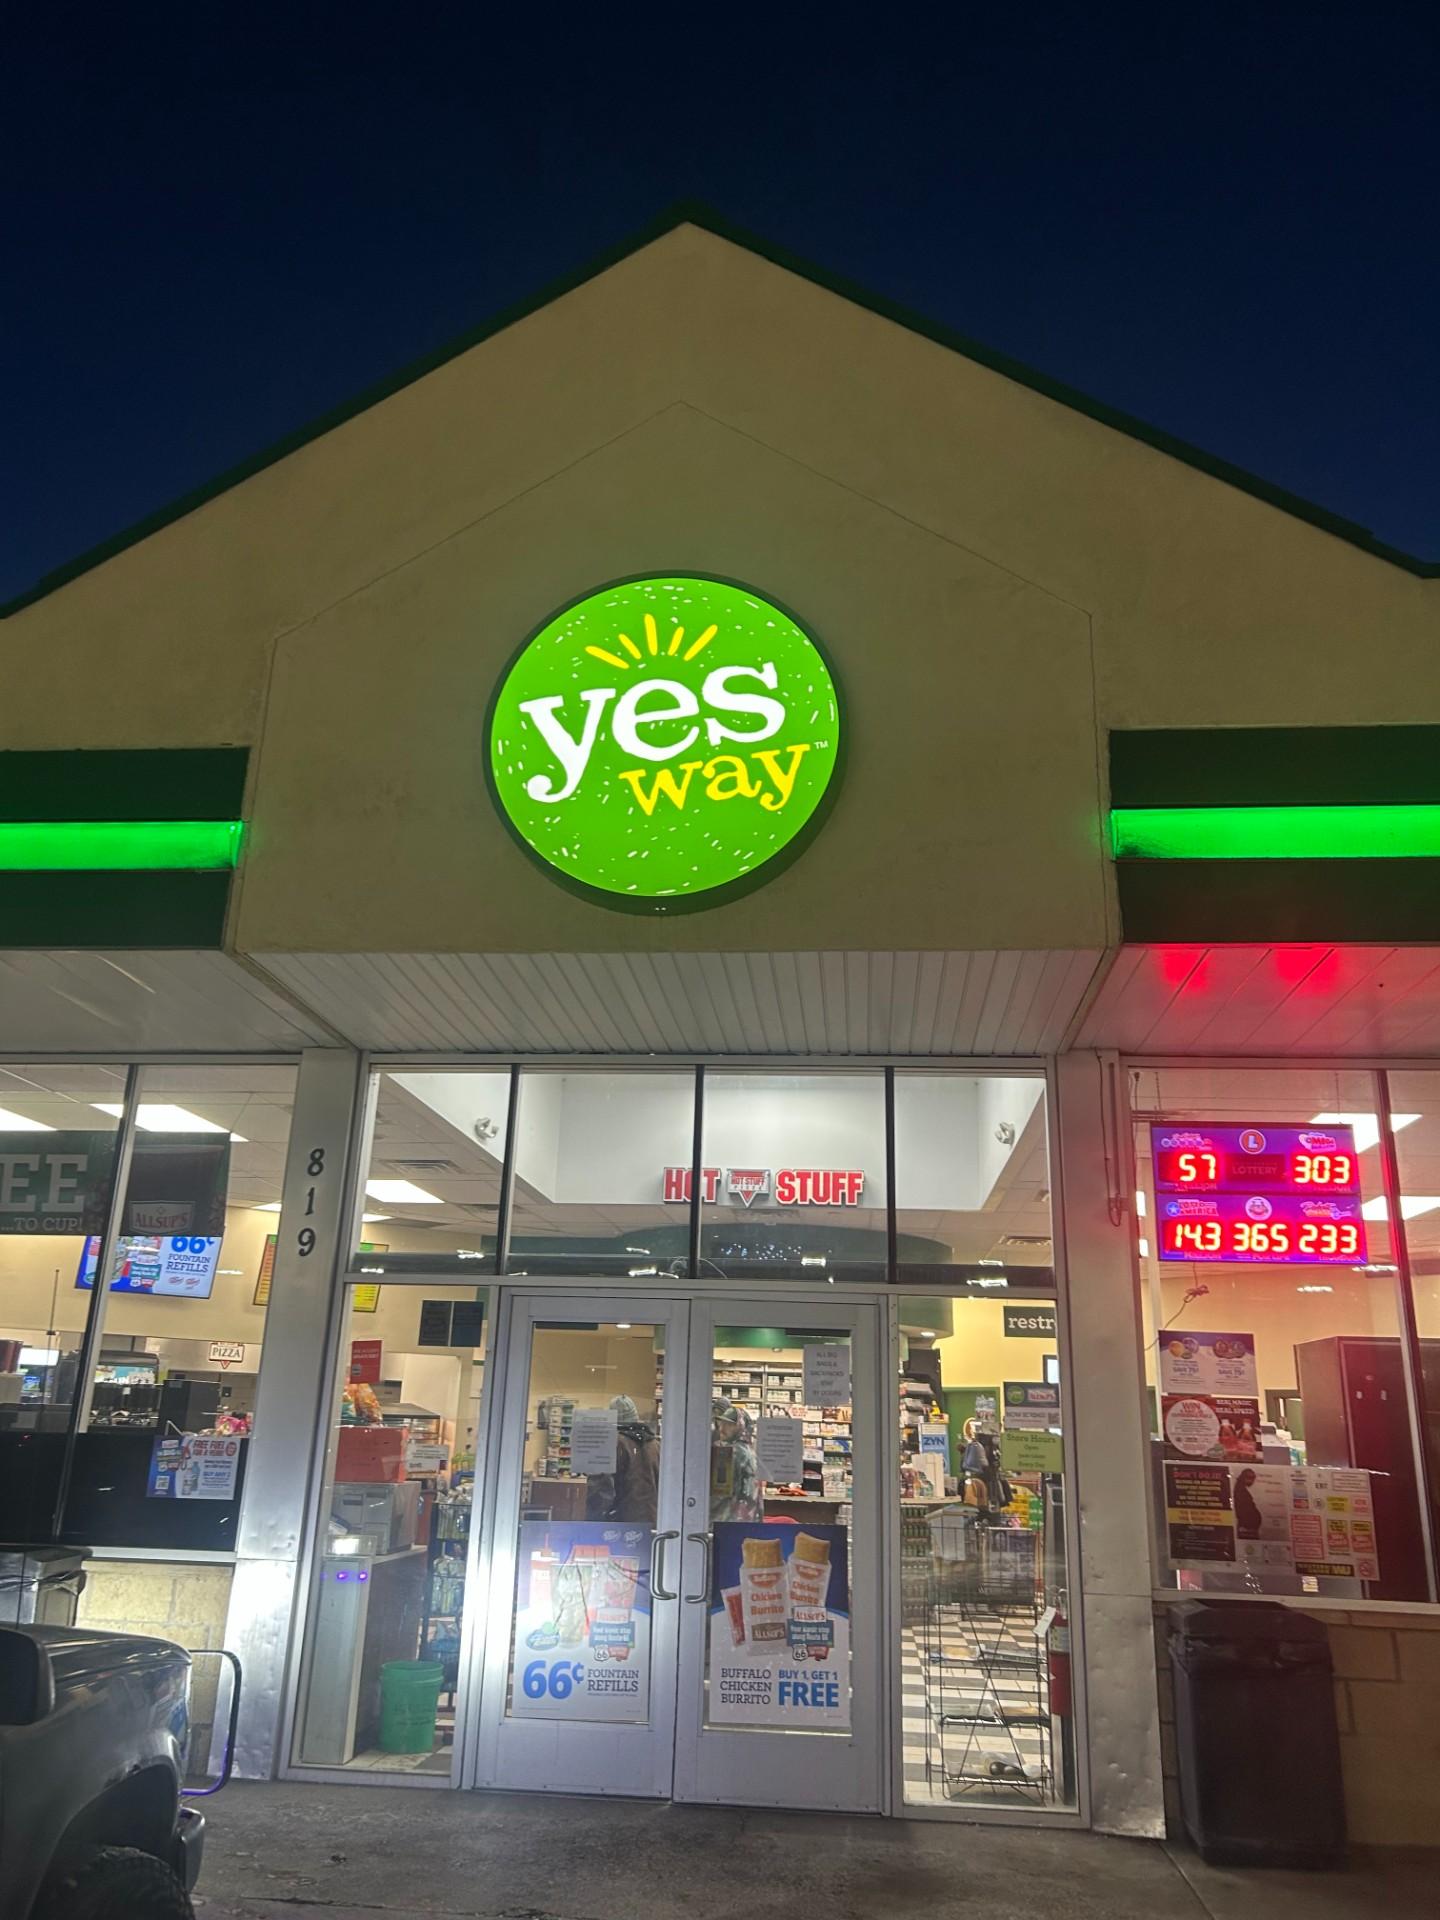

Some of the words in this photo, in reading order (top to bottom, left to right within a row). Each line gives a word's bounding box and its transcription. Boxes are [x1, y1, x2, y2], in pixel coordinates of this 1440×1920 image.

[519, 662, 786, 803] yes
[619, 744, 811, 816] way
[1178, 1153, 1216, 1182] 57
[1232, 1166, 1278, 1175] LOTTERY
[1294, 1155, 1350, 1184] 303
[776, 1169, 864, 1206] STUFF
[42, 1217, 83, 1232] CUP!
[135, 1212, 188, 1229] ALLSUP'S
[1232, 1222, 1289, 1252] 365
[1298, 1224, 1357, 1254] 233
[168, 1253, 212, 1264] FOUNTAIN
[166, 1261, 209, 1273] REFILLS
[1007, 1316, 1056, 1330] restr
[212, 1347, 241, 1358] PIZZA
[922, 1436, 945, 1447] ZYN
[751, 1605, 785, 1616] Burrito
[597, 1650, 608, 1659] 66
[795, 1650, 807, 1658] 66
[522, 1660, 584, 1700] 66¢
[587, 1668, 639, 1679] FOUNTAIN
[720, 1667, 772, 1680] BUFFALO
[778, 1669, 799, 1680] BUY
[811, 1671, 831, 1681] GET
[833, 1671, 838, 1681] 1
[587, 1679, 639, 1693] REFILLS
[720, 1680, 772, 1692] CHICKEN
[720, 1693, 771, 1705] BURRITO
[778, 1682, 839, 1708] FREE
